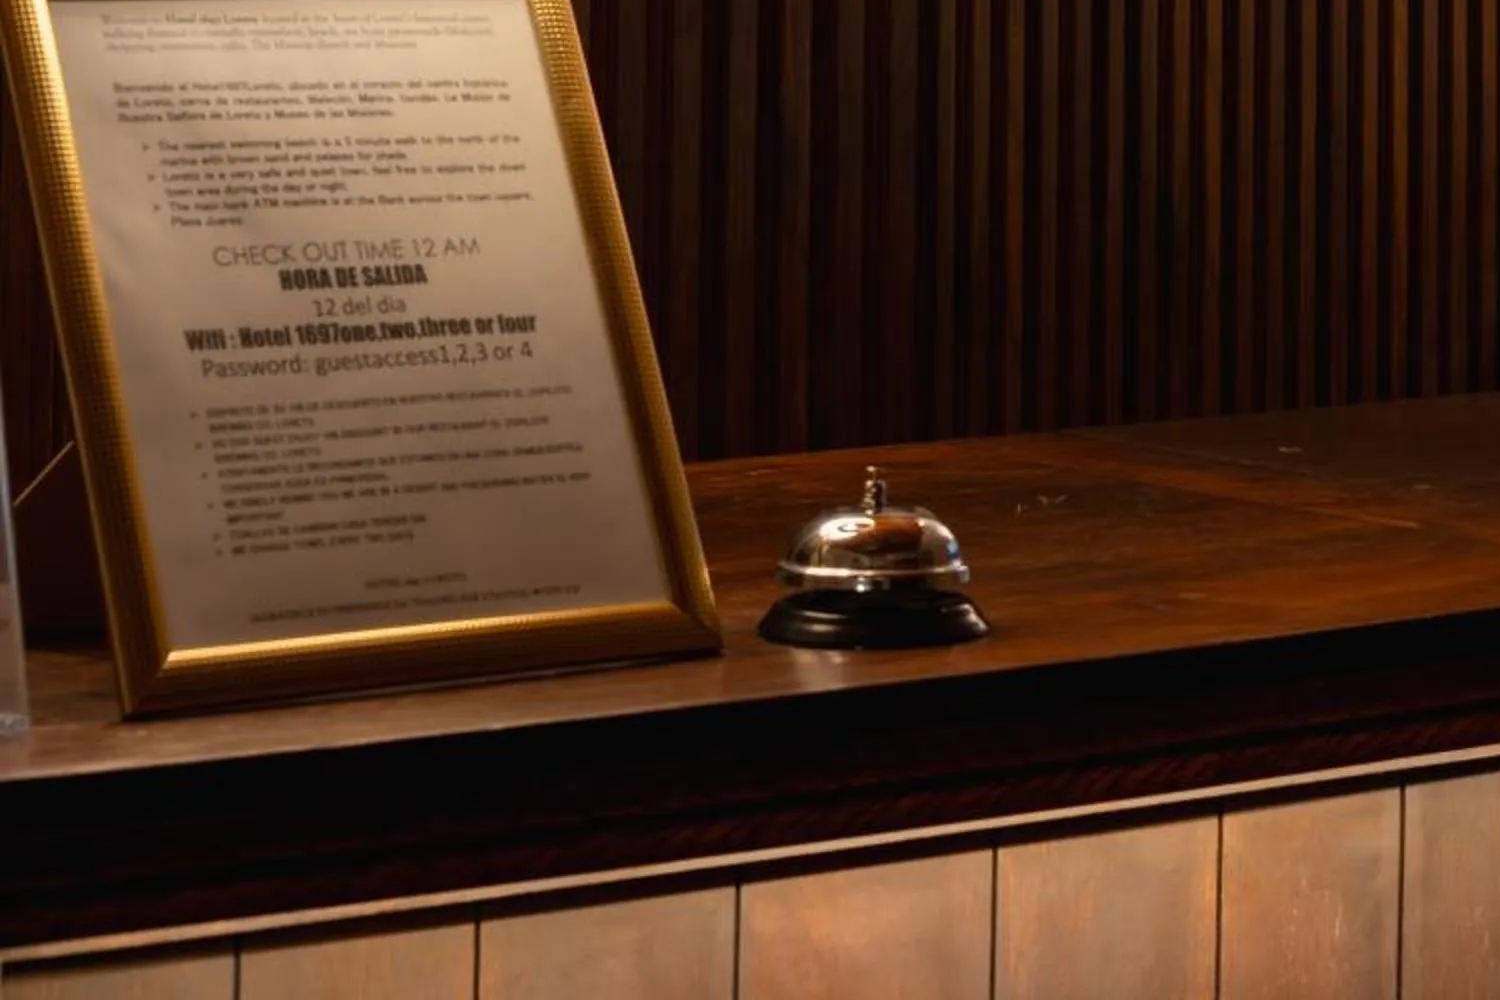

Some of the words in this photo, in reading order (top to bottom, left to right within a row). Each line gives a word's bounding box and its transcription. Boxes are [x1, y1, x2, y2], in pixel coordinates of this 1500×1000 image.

[212, 244, 296, 267] CHECK
[302, 240, 348, 263] OUT
[353, 238, 404, 261] TIME
[412, 237, 438, 259] 12
[443, 235, 481, 256] AM
[278, 268, 333, 291] HORA
[334, 266, 359, 289] DE
[361, 263, 429, 288] SALIDA
[313, 297, 338, 318] 12
[342, 296, 372, 316] del
[238, 324, 292, 349] Hotel
[474, 316, 494, 335] or
[202, 352, 311, 379] Password:
[493, 344, 514, 361] or
[519, 340, 533, 358] 4
